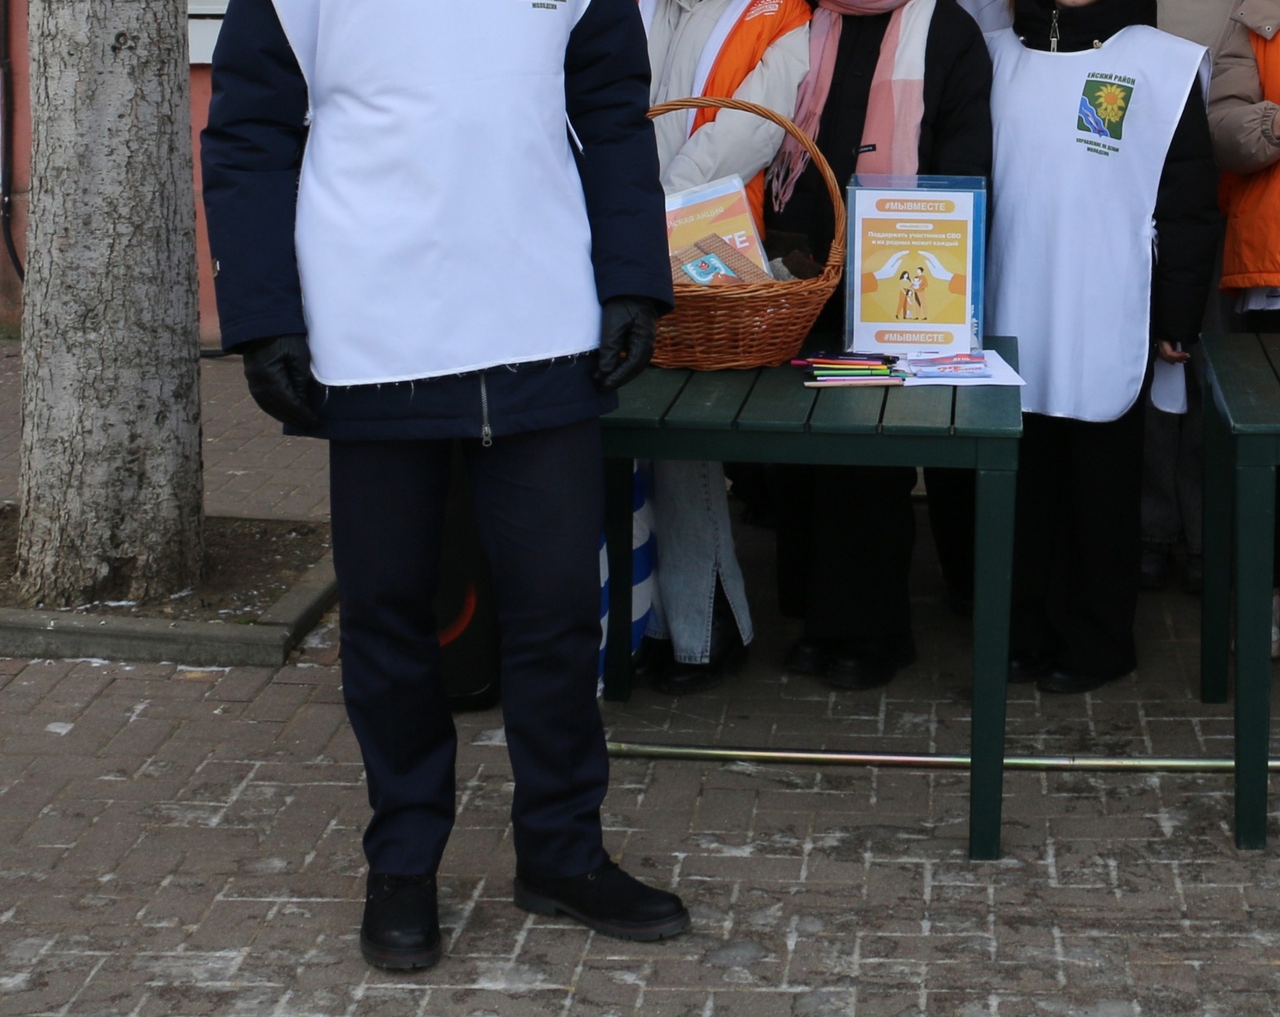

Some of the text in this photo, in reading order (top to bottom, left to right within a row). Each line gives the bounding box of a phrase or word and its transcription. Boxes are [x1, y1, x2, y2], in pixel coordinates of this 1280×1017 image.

[1087, 71, 1136, 86] ЕЙСКИЙ РАЙОН
[884, 201, 946, 211] #МЫВМЕСТЕ
[696, 207, 725, 221] АКЦИЯ
[868, 231, 908, 239] Поддержать
[884, 333, 945, 342] #МЫВМЕСТЕ
